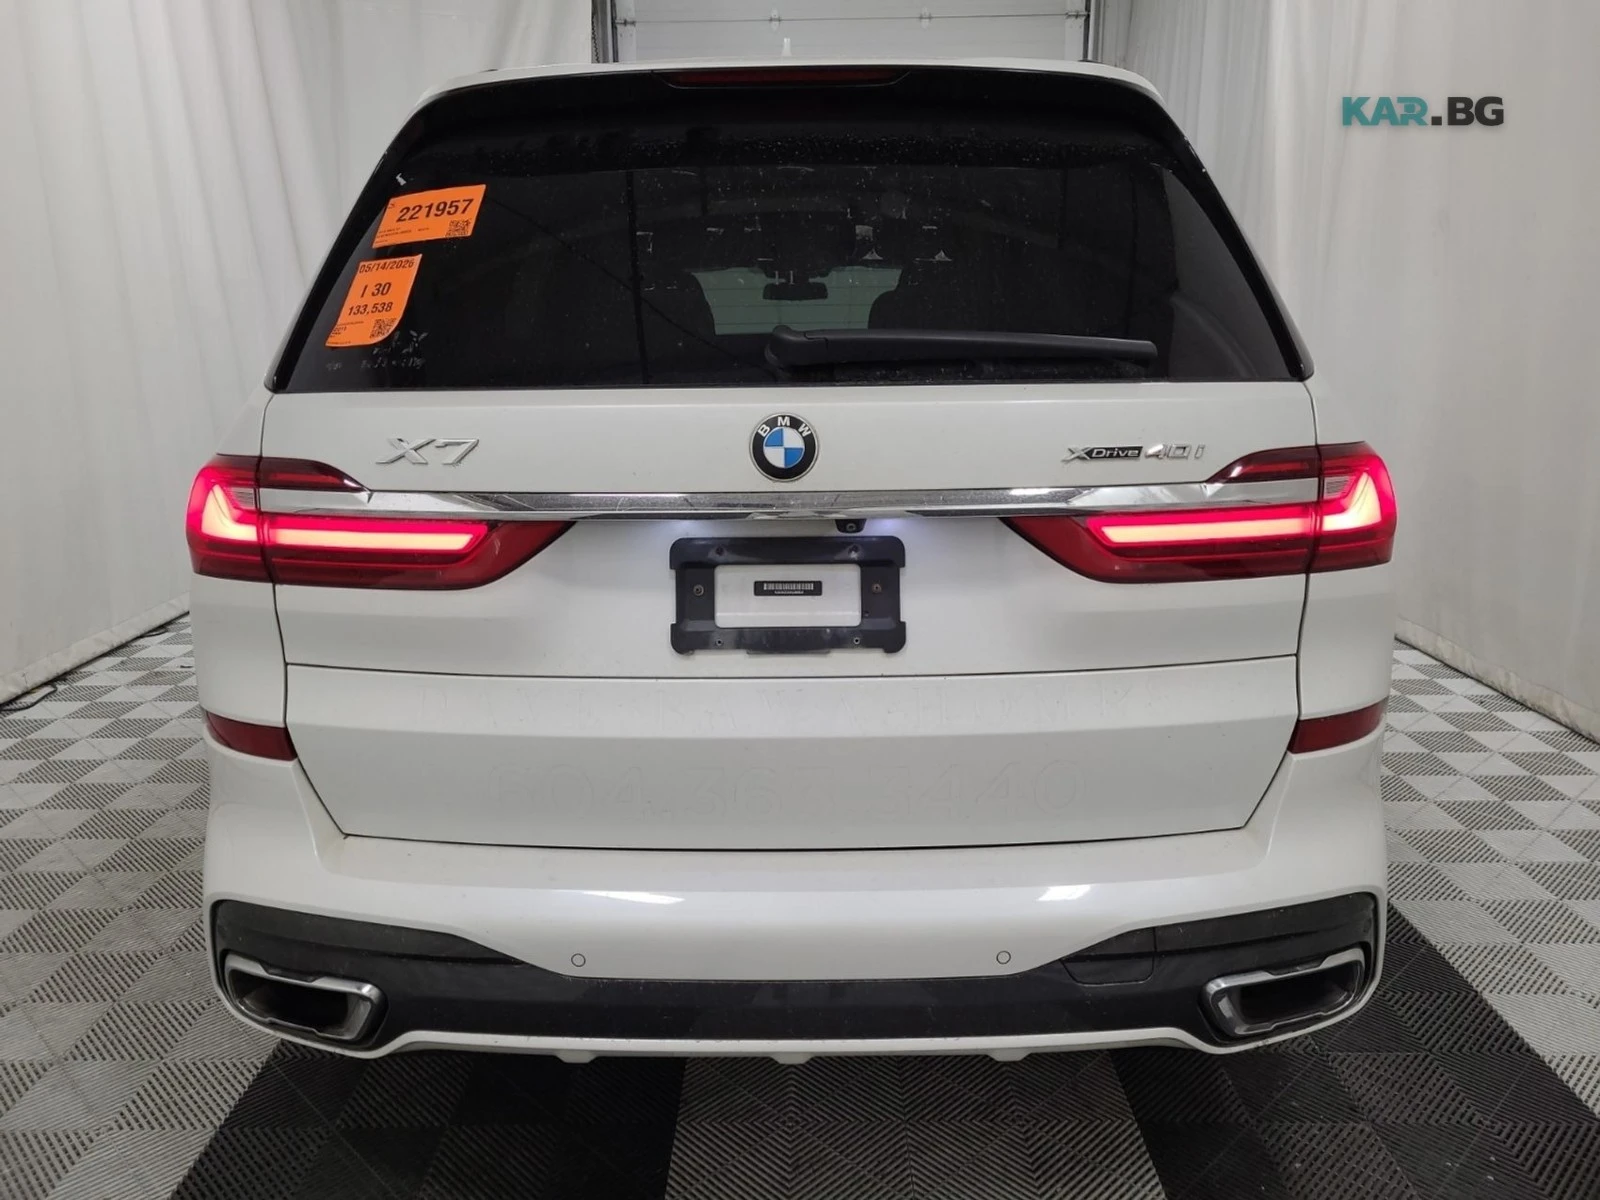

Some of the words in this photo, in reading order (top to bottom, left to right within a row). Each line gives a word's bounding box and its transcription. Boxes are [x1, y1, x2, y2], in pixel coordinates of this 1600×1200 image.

[396, 198, 474, 223] 221957
[359, 259, 415, 274] 05/14/2026
[371, 282, 392, 297] 30
[348, 301, 394, 316] 133,538
[757, 416, 812, 437] BMW
[375, 437, 479, 466] X7
